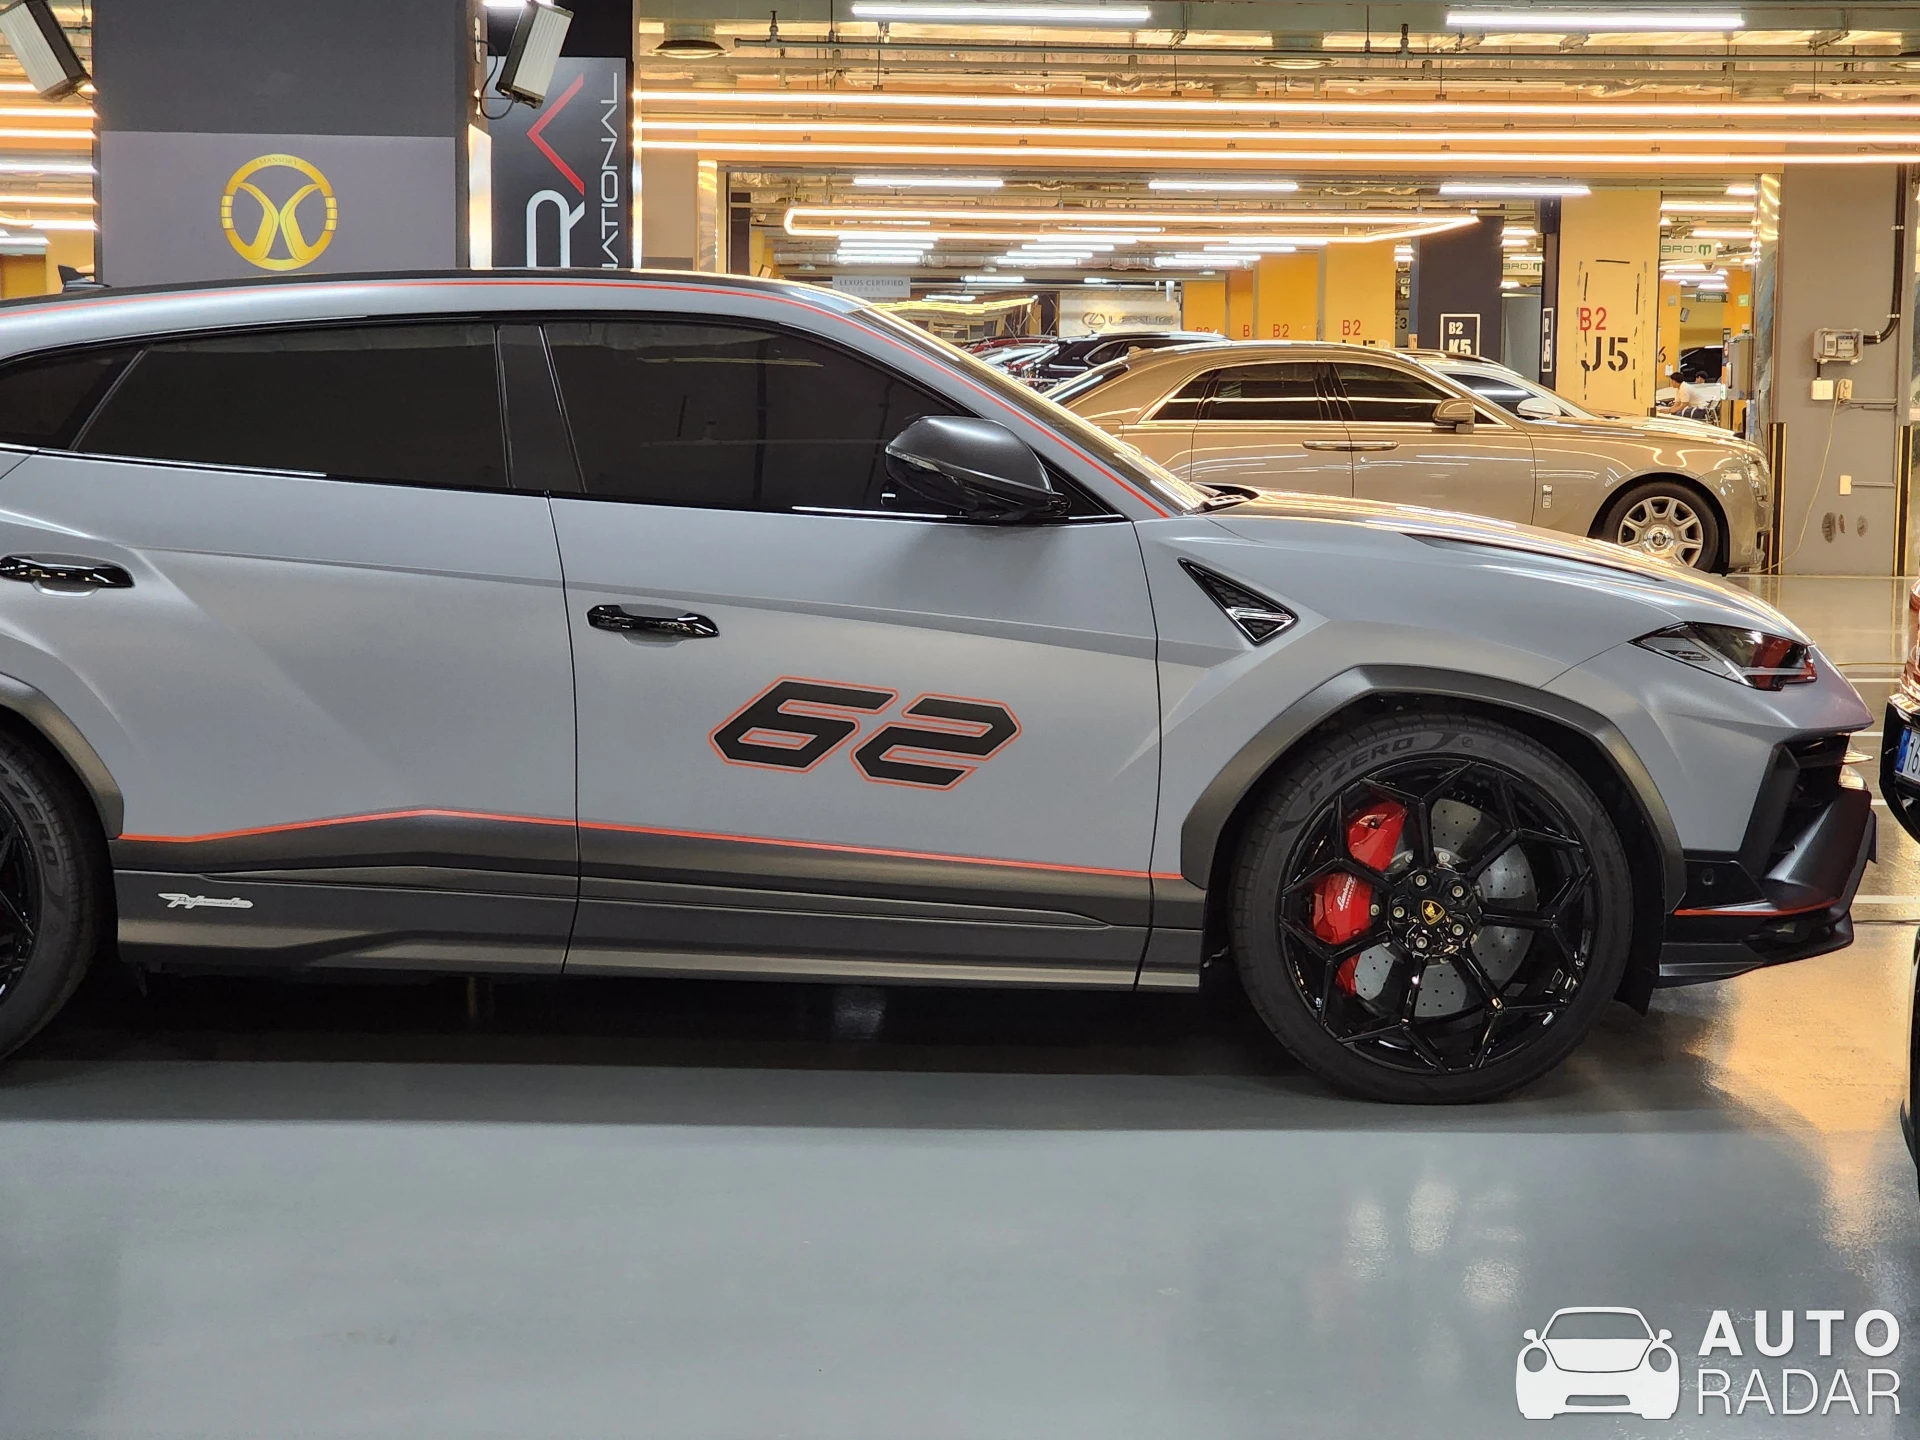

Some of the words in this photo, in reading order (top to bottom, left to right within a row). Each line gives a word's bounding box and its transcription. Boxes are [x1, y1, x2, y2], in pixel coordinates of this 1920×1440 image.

[601, 72, 619, 269] ATIONAL
[840, 279, 865, 287] LEXUS
[866, 279, 904, 287] CERTIFIED
[1108, 315, 1174, 326] LEXUS
[1579, 306, 1607, 331] B2
[1273, 323, 1290, 338] B2
[1342, 319, 1361, 336] B2
[1448, 321, 1464, 335] B2
[1448, 338, 1472, 355] K5
[1581, 336, 1628, 372] J5
[708, 675, 1022, 791] 62
[1330, 736, 1415, 784] ZERO
